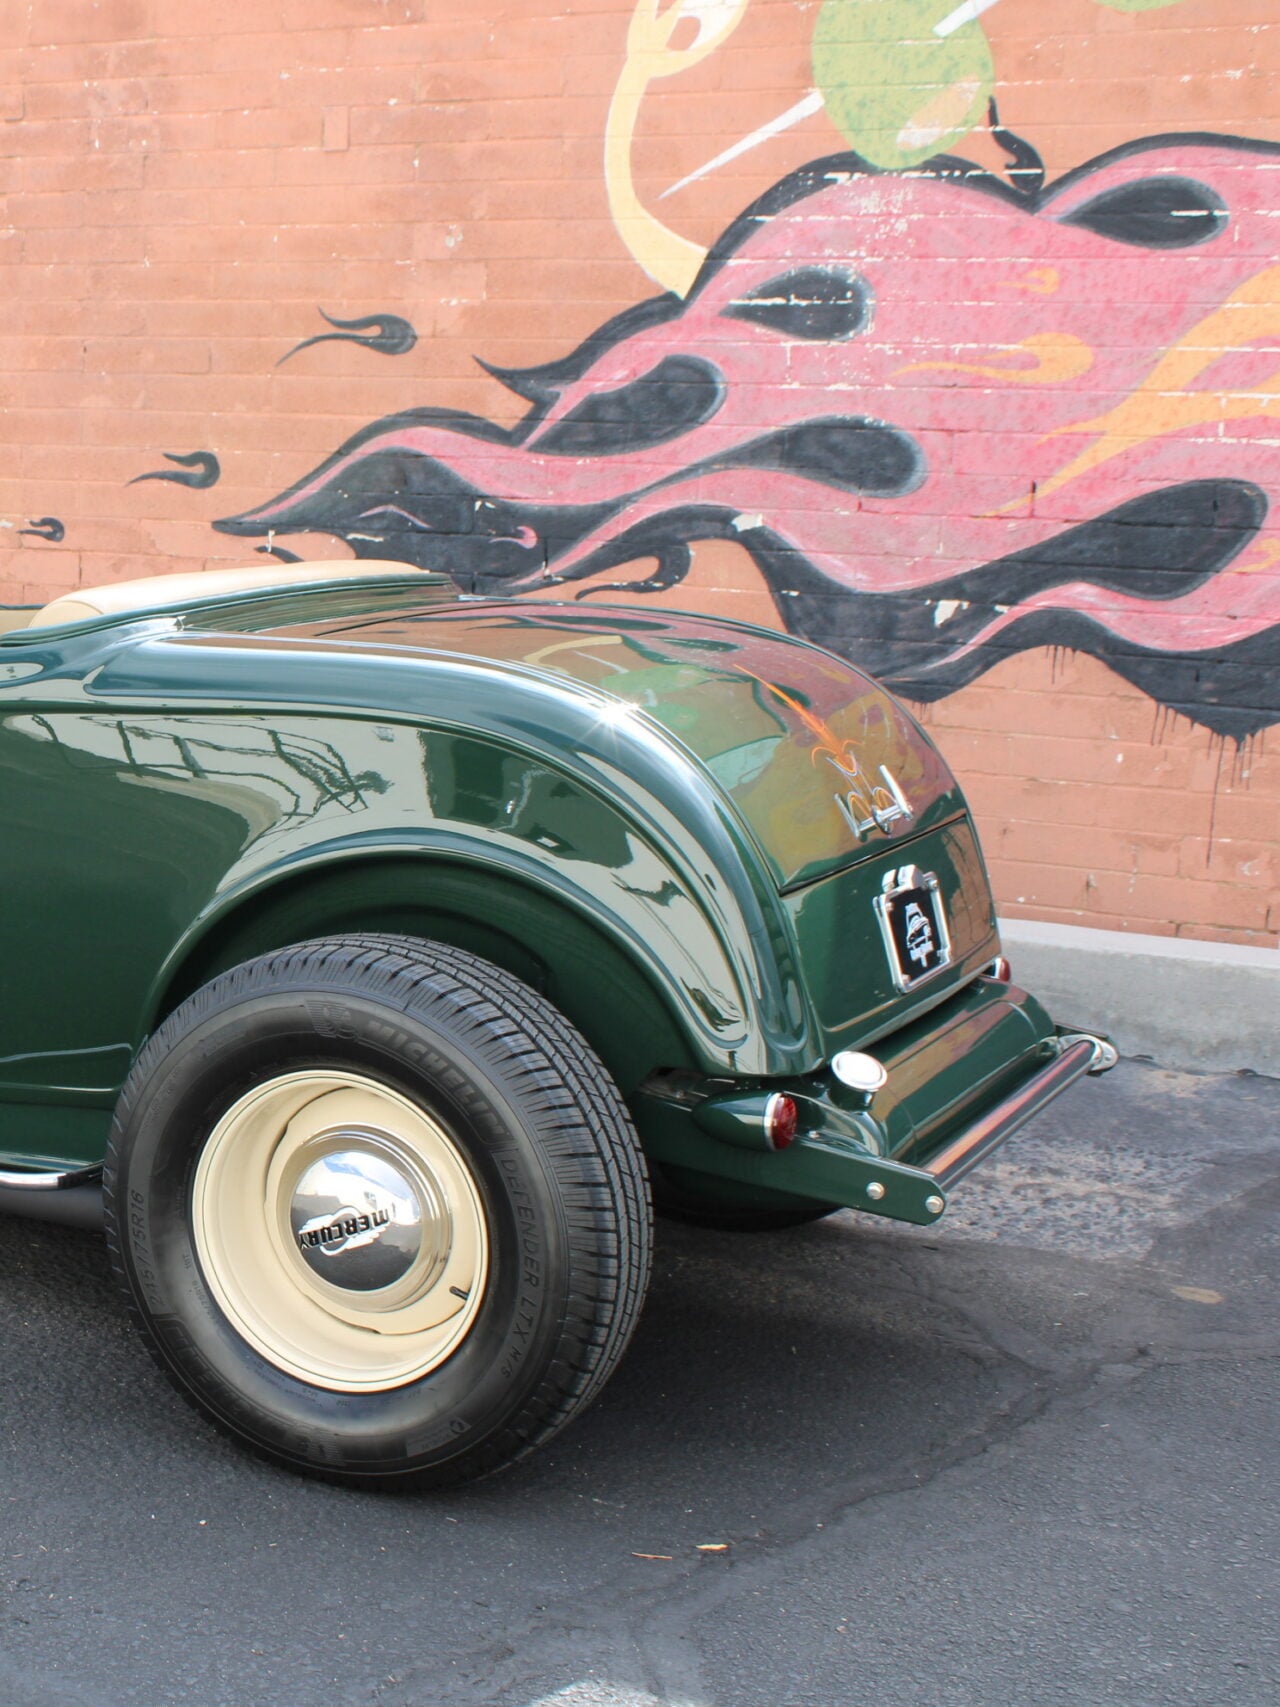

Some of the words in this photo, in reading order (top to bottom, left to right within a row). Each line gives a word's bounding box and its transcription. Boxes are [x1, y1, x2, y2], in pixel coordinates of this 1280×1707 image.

[366, 1019, 514, 1142] MICHELIN
[130, 1189, 165, 1307] 245/75R16
[299, 1207, 390, 1249] MERCURY
[500, 1157, 541, 1288] DEFENDER
[512, 1293, 537, 1343] LTX
